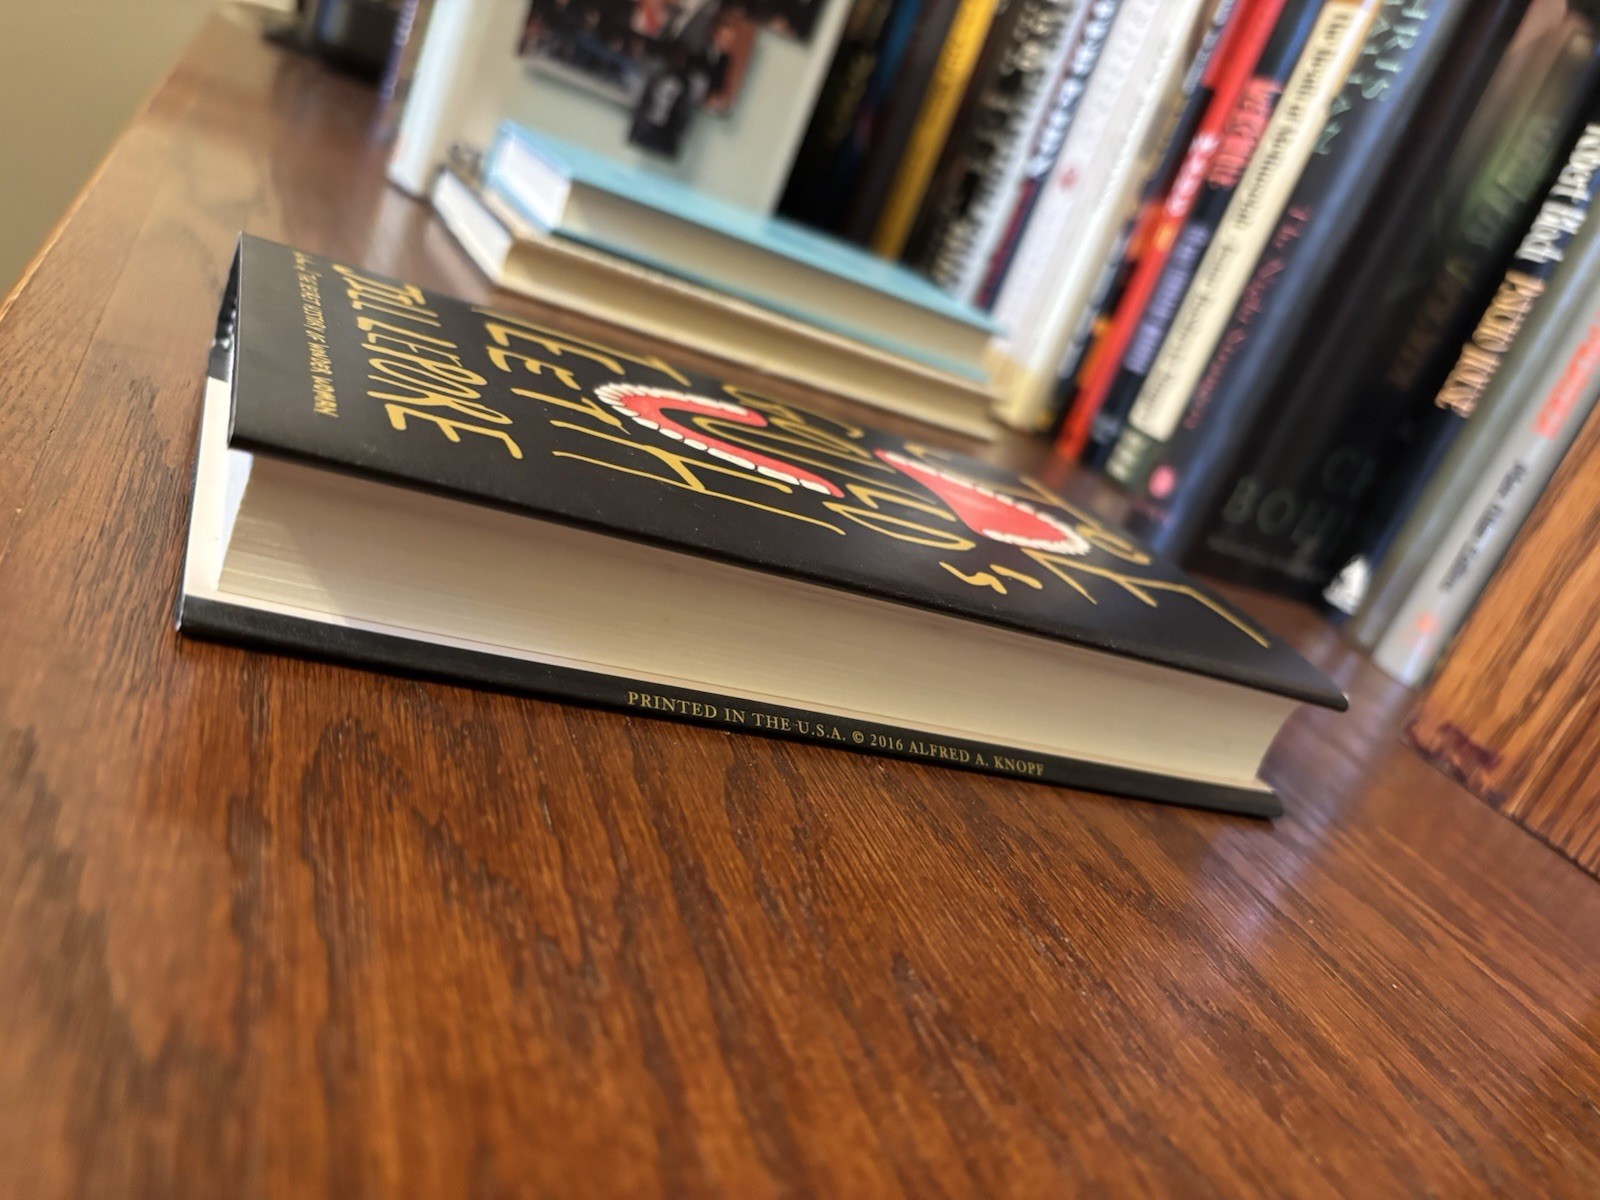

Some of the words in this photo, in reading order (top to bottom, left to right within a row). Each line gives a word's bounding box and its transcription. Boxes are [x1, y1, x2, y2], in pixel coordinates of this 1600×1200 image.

[332, 264, 442, 328] JILL
[307, 341, 333, 375] WONDER
[311, 375, 339, 418] WOMAN
[356, 316, 523, 460] LEPORE
[1434, 341, 1502, 419] HOUSE
[471, 305, 848, 536] TEETH
[627, 691, 718, 719] PRINTED
[724, 707, 746, 724] IN
[752, 712, 791, 731] THE
[796, 719, 846, 741] U.S.A.
[870, 733, 904, 751] 2016
[909, 740, 970, 763] ALFRED
[974, 753, 989, 767] A.
[994, 755, 1045, 777] KNOPF
